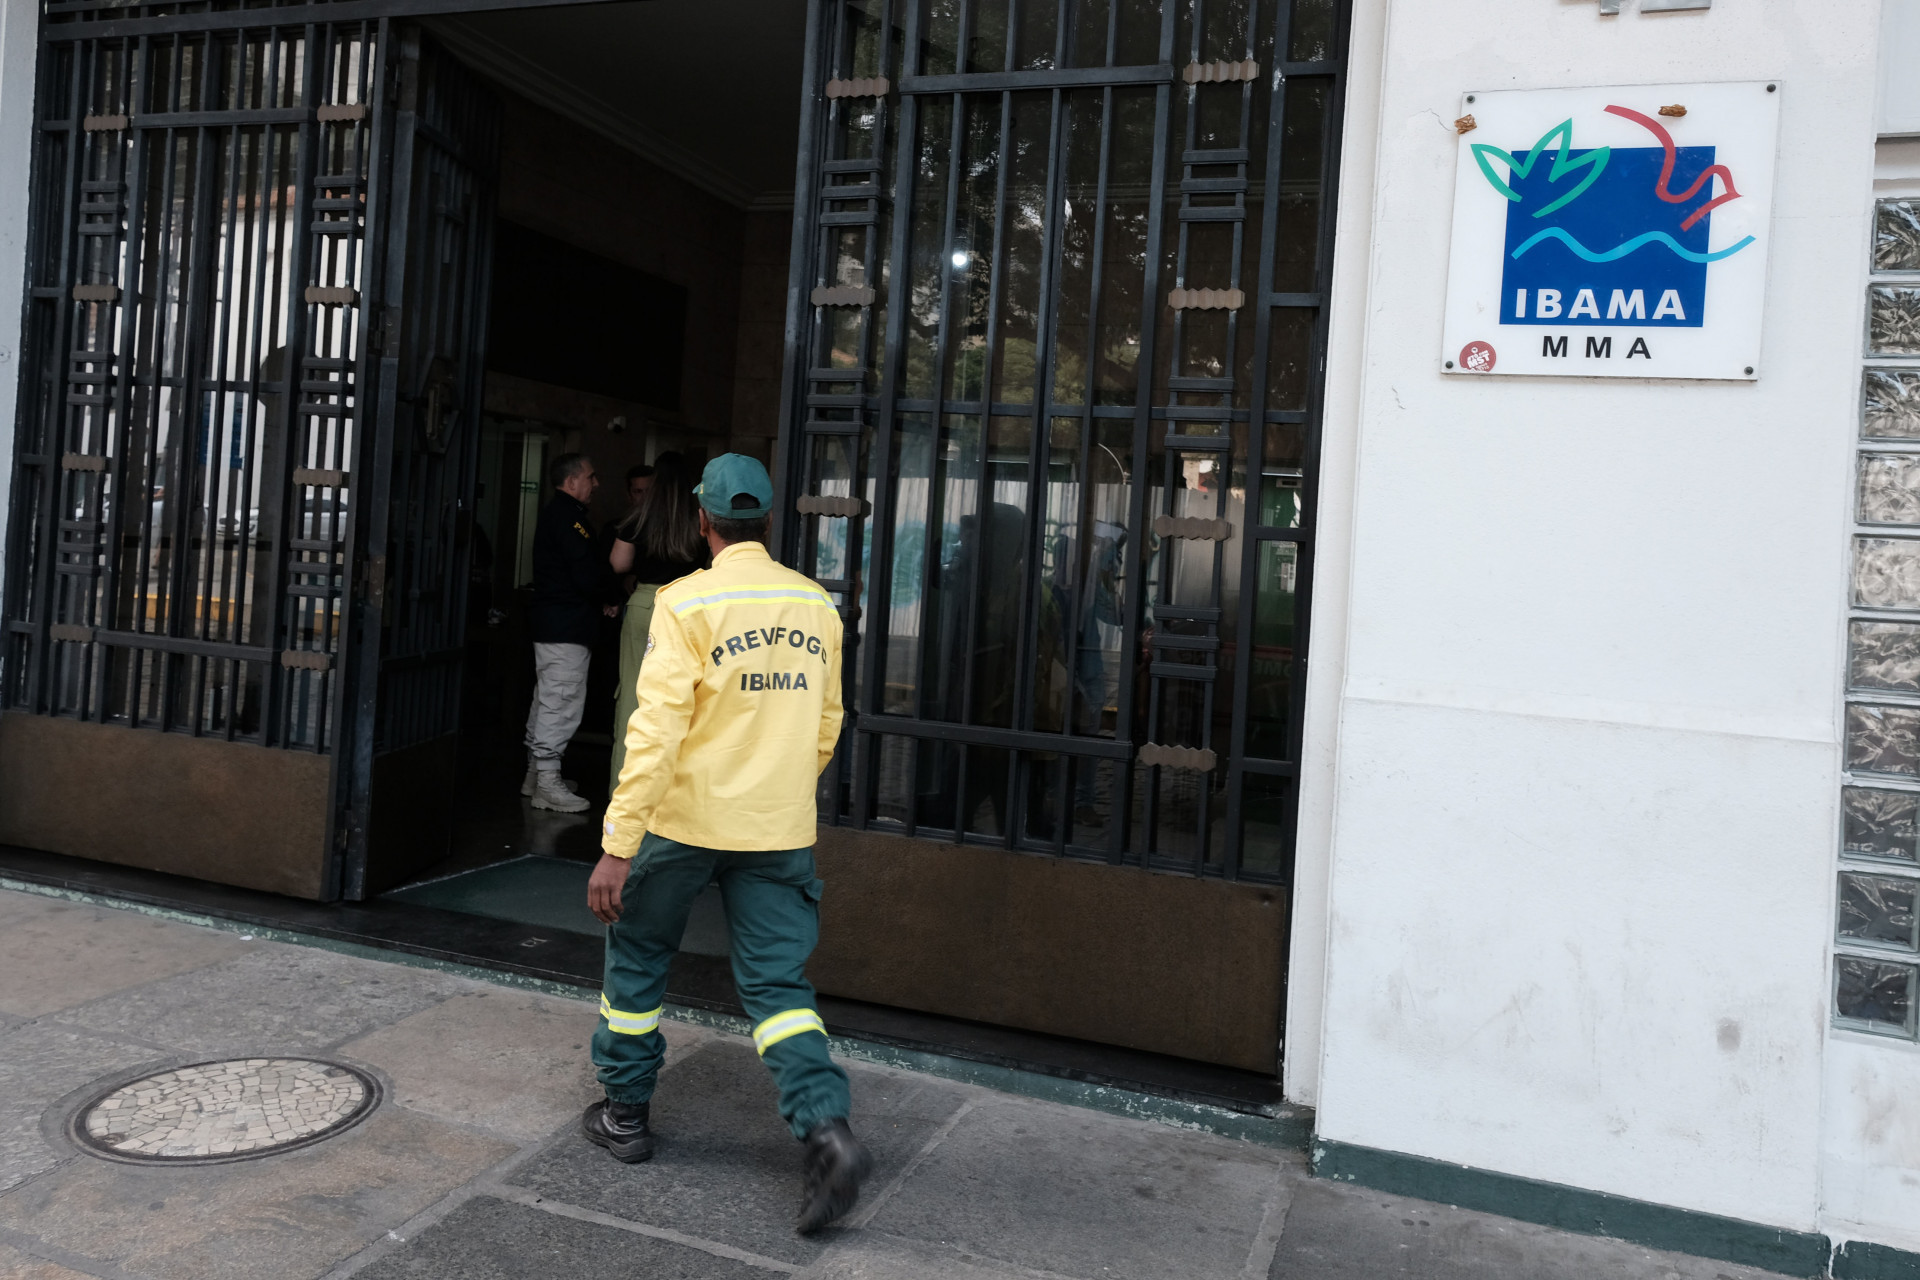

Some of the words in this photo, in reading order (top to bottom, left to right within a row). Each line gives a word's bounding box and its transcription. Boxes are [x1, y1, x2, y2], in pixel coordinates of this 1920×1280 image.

[1515, 288, 1687, 320] IBAMA
[1542, 336, 1652, 359] MMA
[1467, 353, 1490, 369] MST
[572, 521, 591, 540] PRF
[710, 626, 827, 667] PREVFOGO
[740, 672, 808, 691] IBAMA
